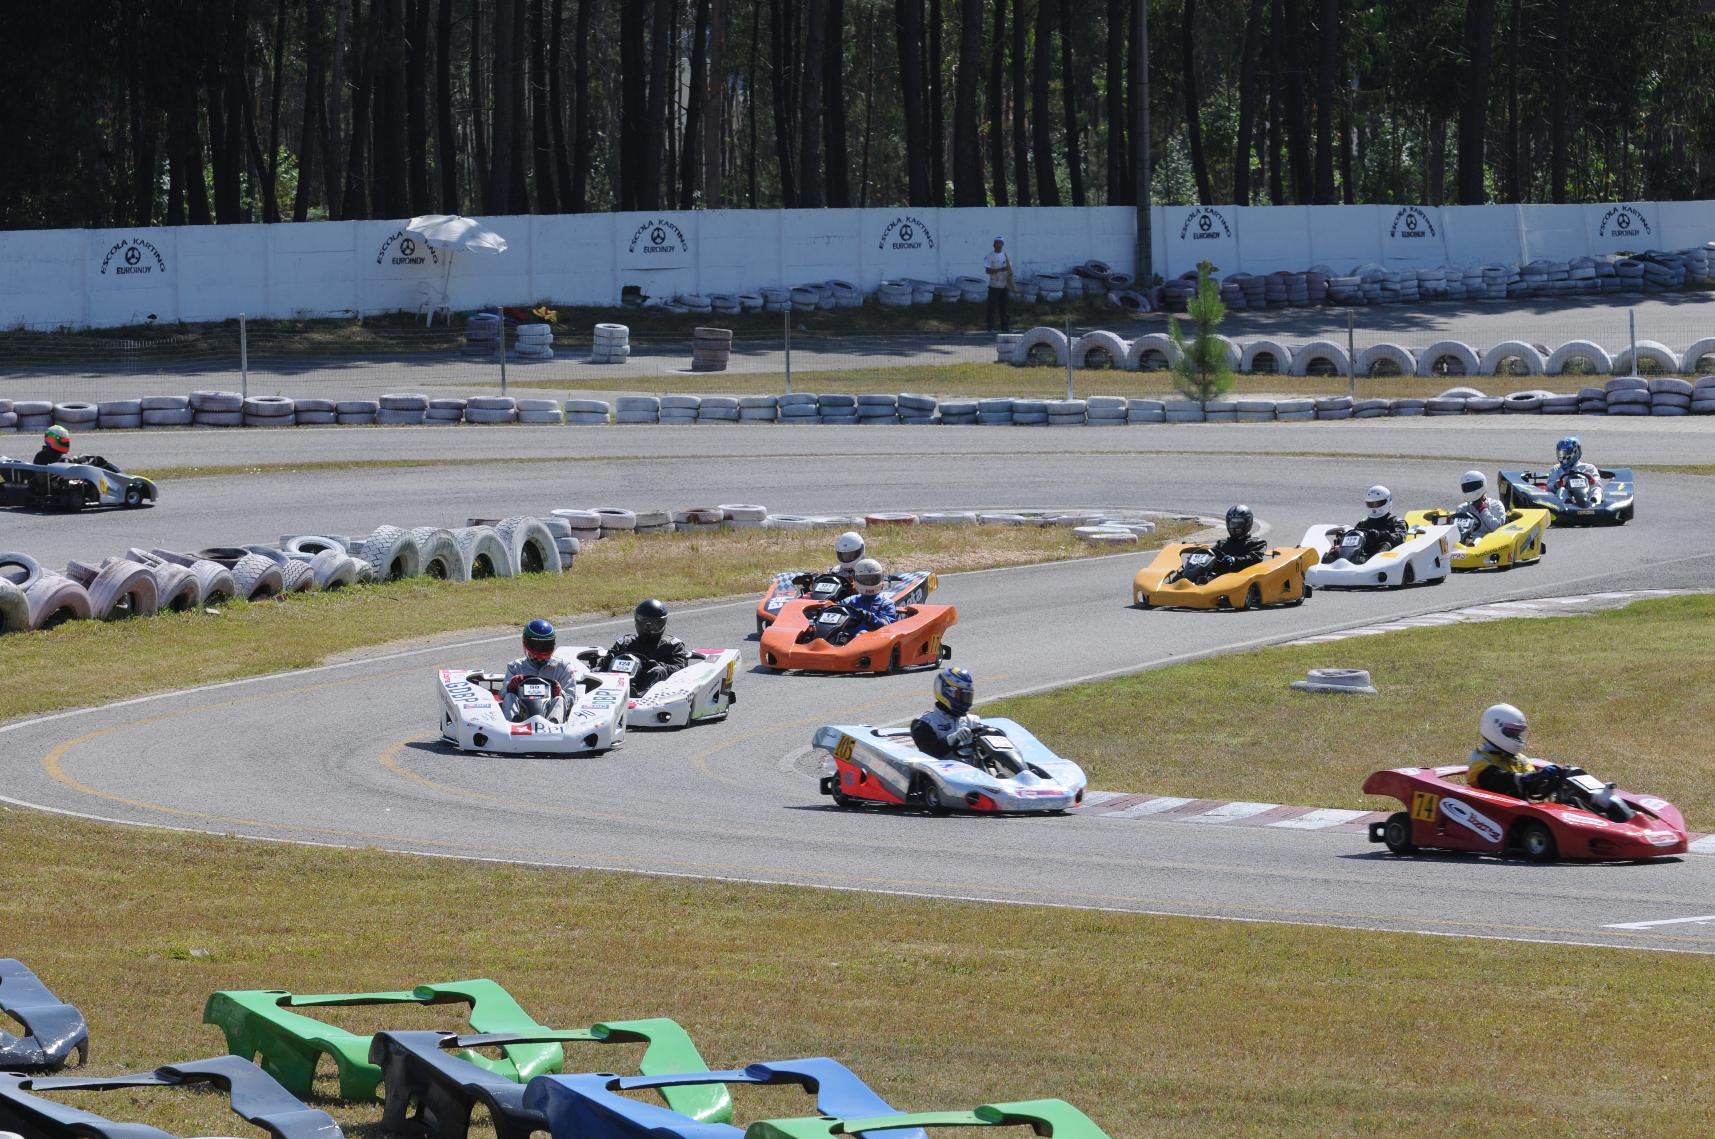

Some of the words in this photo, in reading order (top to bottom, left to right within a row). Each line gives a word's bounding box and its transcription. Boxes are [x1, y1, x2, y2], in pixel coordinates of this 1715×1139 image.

[629, 220, 655, 253] ESCOLA
[658, 219, 688, 252] KARTING
[879, 217, 902, 250] ESCOLA
[905, 216, 934, 248] KARTING
[1181, 208, 1202, 240] ESCOLA
[1204, 207, 1232, 238] KARTING
[1193, 232, 1221, 240] EUROINDY
[1391, 207, 1407, 237] ESCOLA
[1409, 206, 1436, 237] KARTING
[1599, 207, 1619, 237] ESCOLA
[1622, 206, 1652, 235] KARTING
[1611, 229, 1640, 238] EUROINDY
[100, 239, 128, 274] ESCOLA
[133, 238, 166, 272] KARTING
[376, 231, 403, 264] ESCOLA
[392, 257, 426, 265] EUROINDY
[116, 266, 152, 275] EUROINDY
[534, 722, 565, 734] BPI
[835, 735, 857, 761] 105
[1416, 792, 1435, 819] 74
